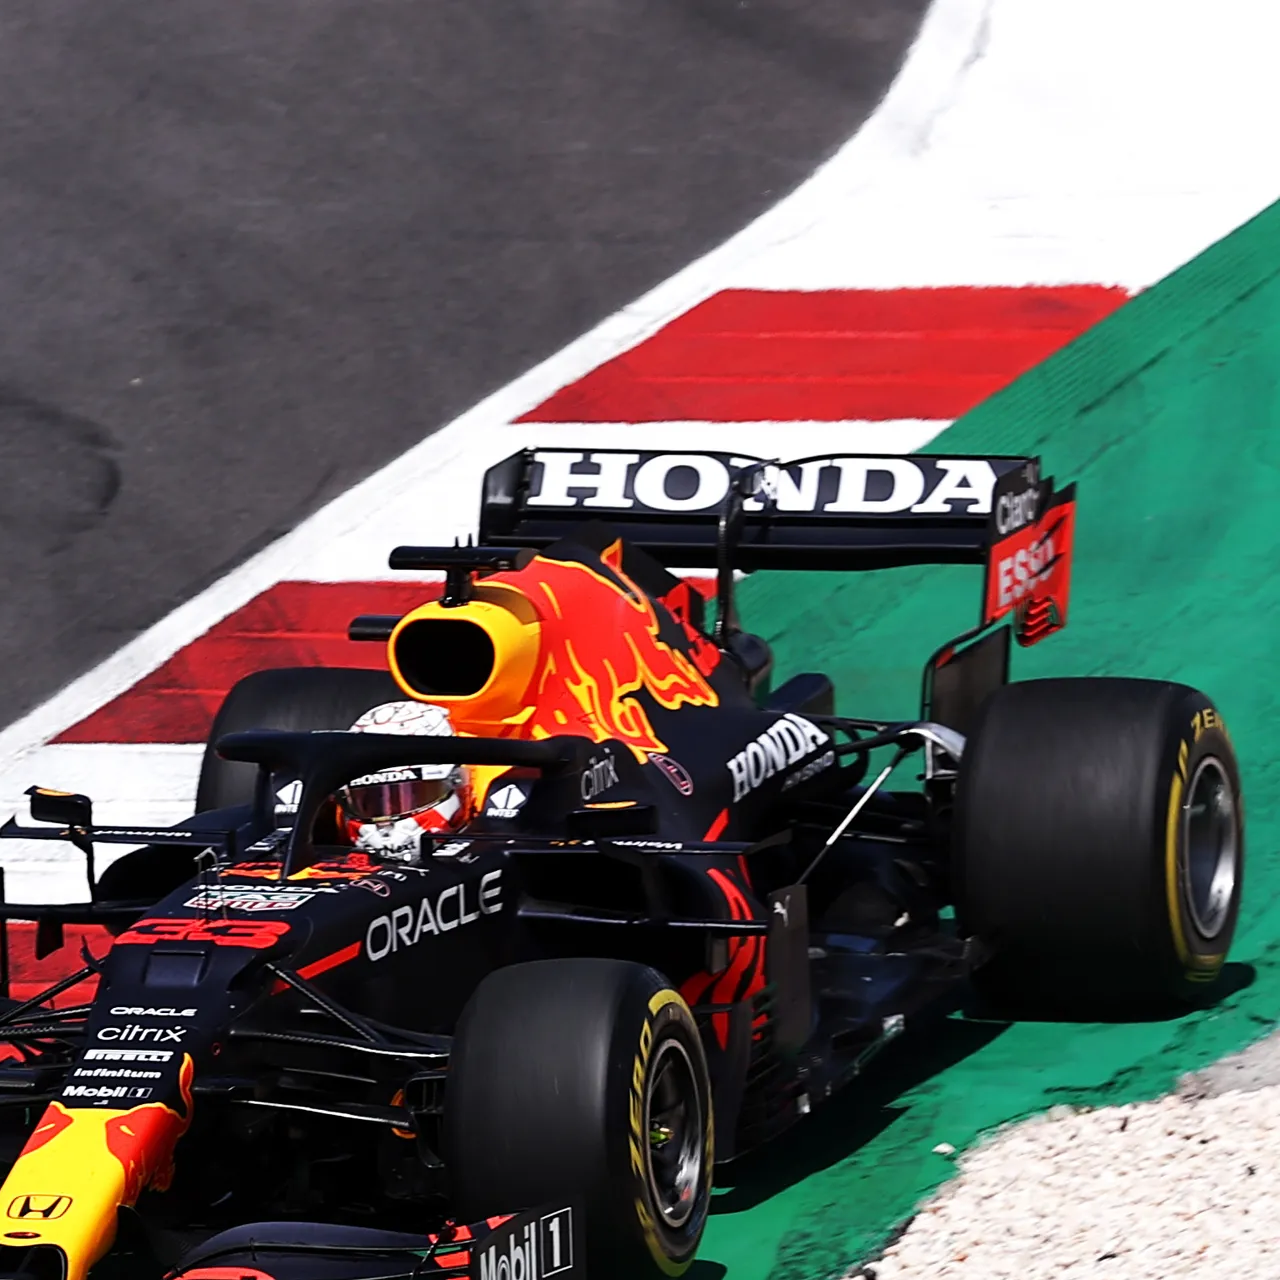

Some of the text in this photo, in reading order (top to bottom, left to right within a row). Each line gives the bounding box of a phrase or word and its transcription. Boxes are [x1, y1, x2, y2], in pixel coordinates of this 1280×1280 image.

[526, 452, 998, 514] HONDA
[726, 713, 829, 803] HONDA
[366, 869, 504, 962] ORACLE
[114, 918, 291, 949] 33
[109, 1006, 198, 1017] ORACLE
[96, 1024, 188, 1043] citrix
[83, 1049, 175, 1062] PIRELLI
[73, 1068, 162, 1079] infinitum
[62, 1085, 128, 1098] Mobil
